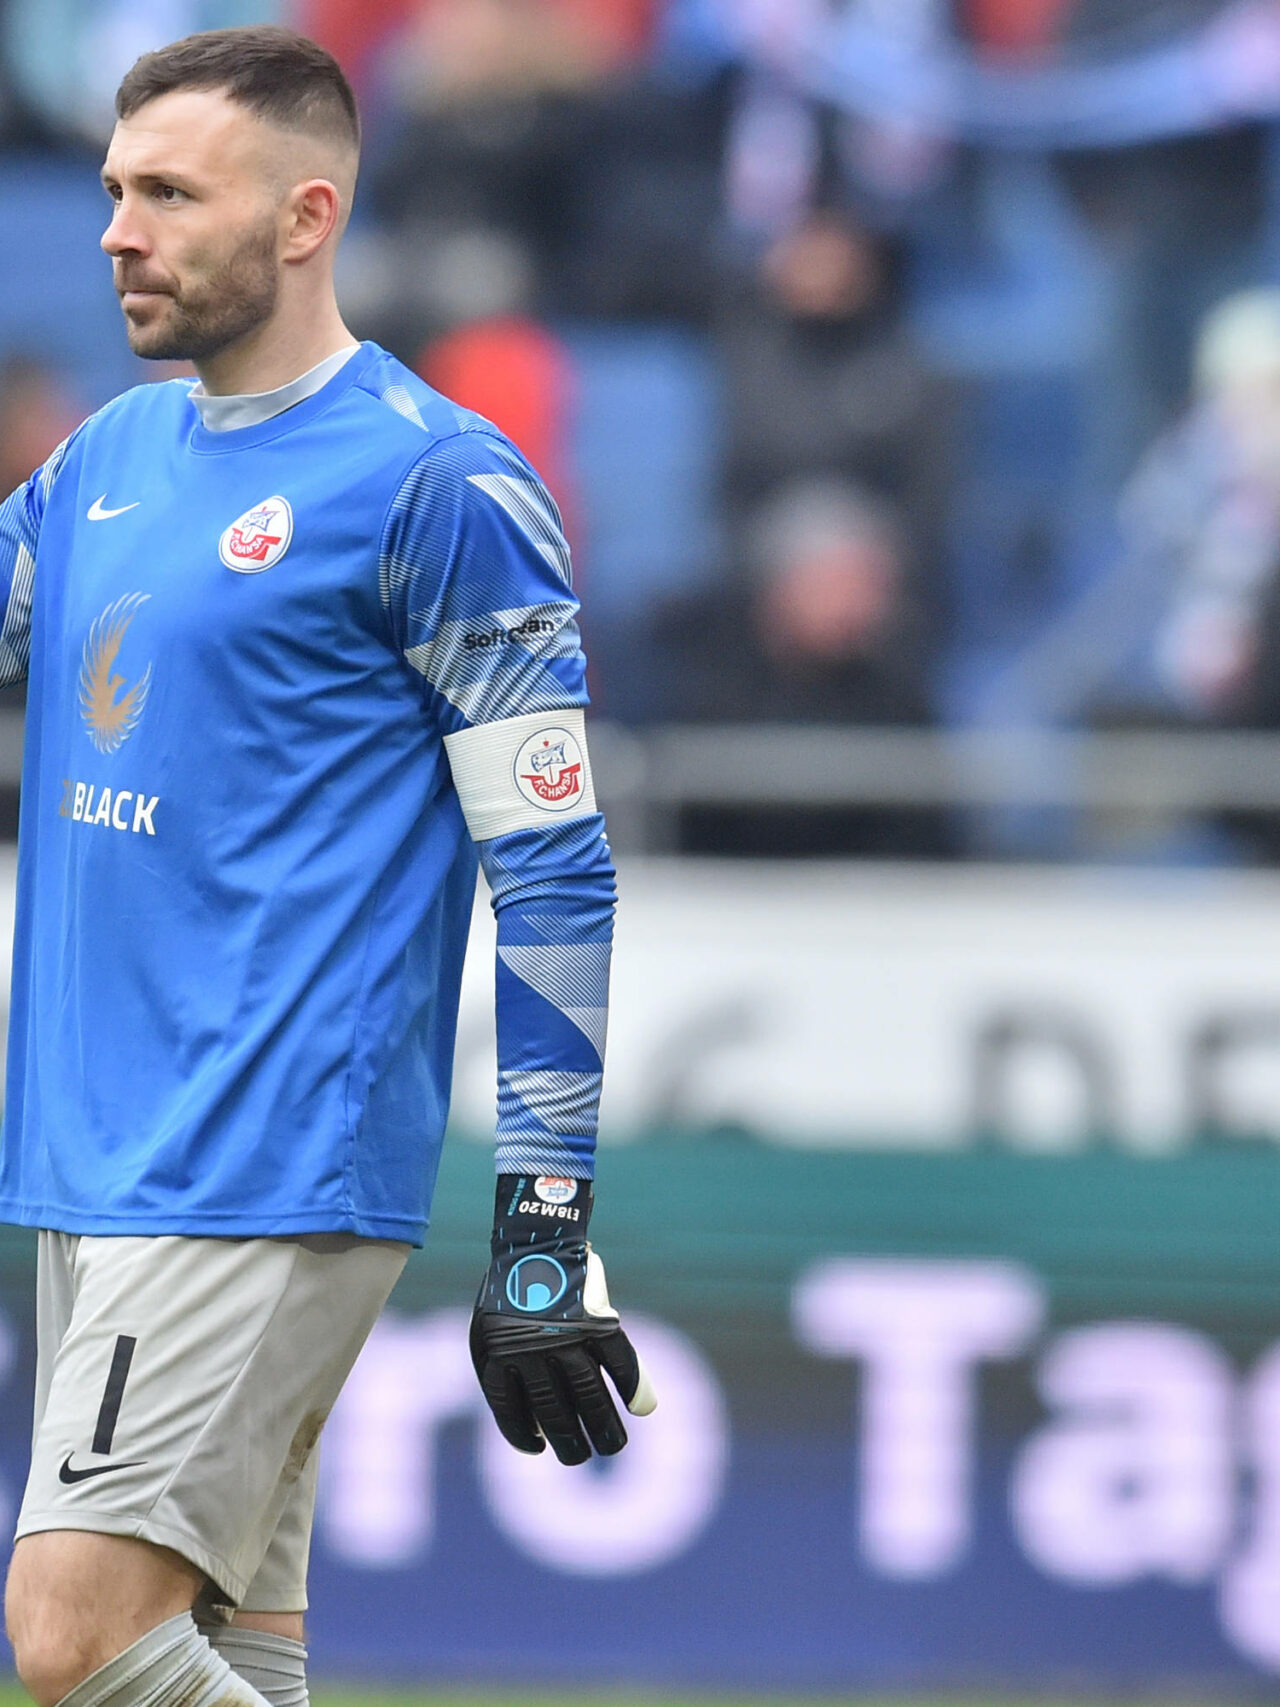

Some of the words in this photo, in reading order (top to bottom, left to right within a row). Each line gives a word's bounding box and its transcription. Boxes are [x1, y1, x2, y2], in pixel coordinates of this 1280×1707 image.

[72, 781, 160, 835] BLACK
[91, 1334, 138, 1455] 1
[790, 1255, 1280, 1680] Ta
